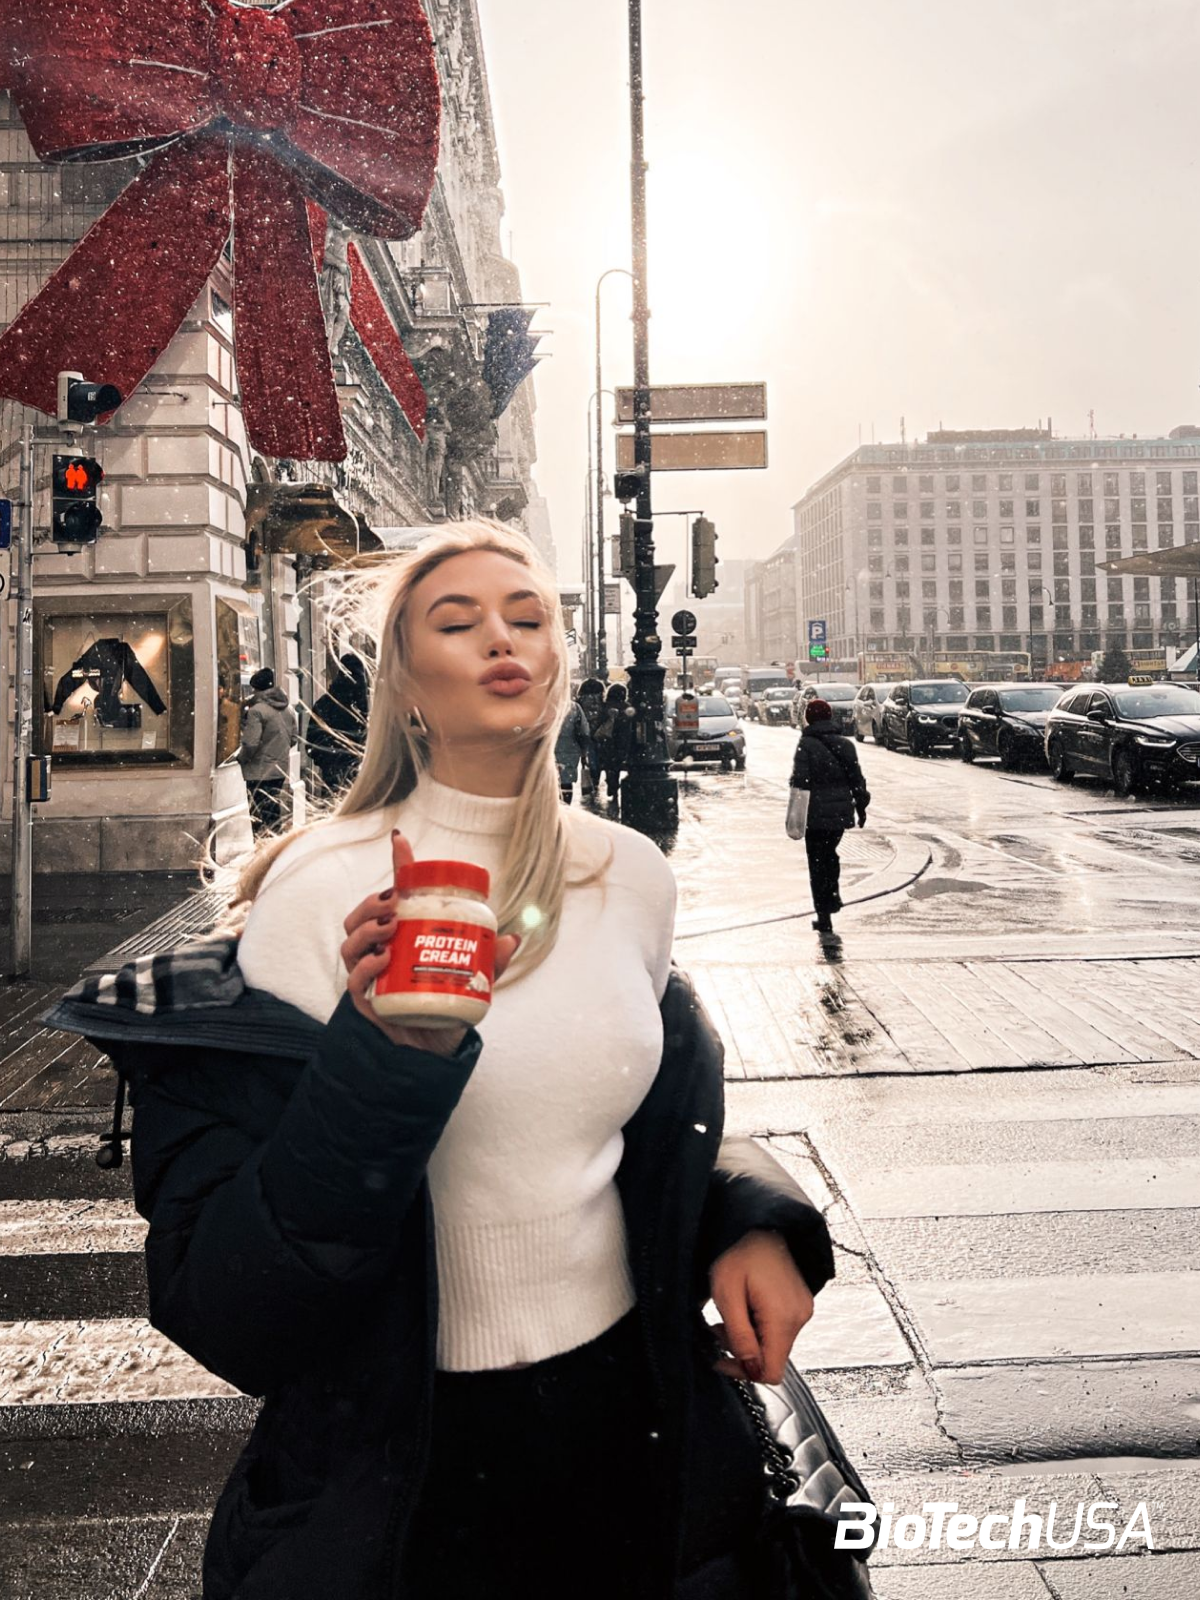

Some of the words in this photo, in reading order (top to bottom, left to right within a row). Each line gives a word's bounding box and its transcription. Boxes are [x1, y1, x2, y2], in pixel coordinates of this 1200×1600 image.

[811, 625, 823, 639] P
[414, 934, 478, 953] PROTEIN
[419, 949, 472, 966] CREAM
